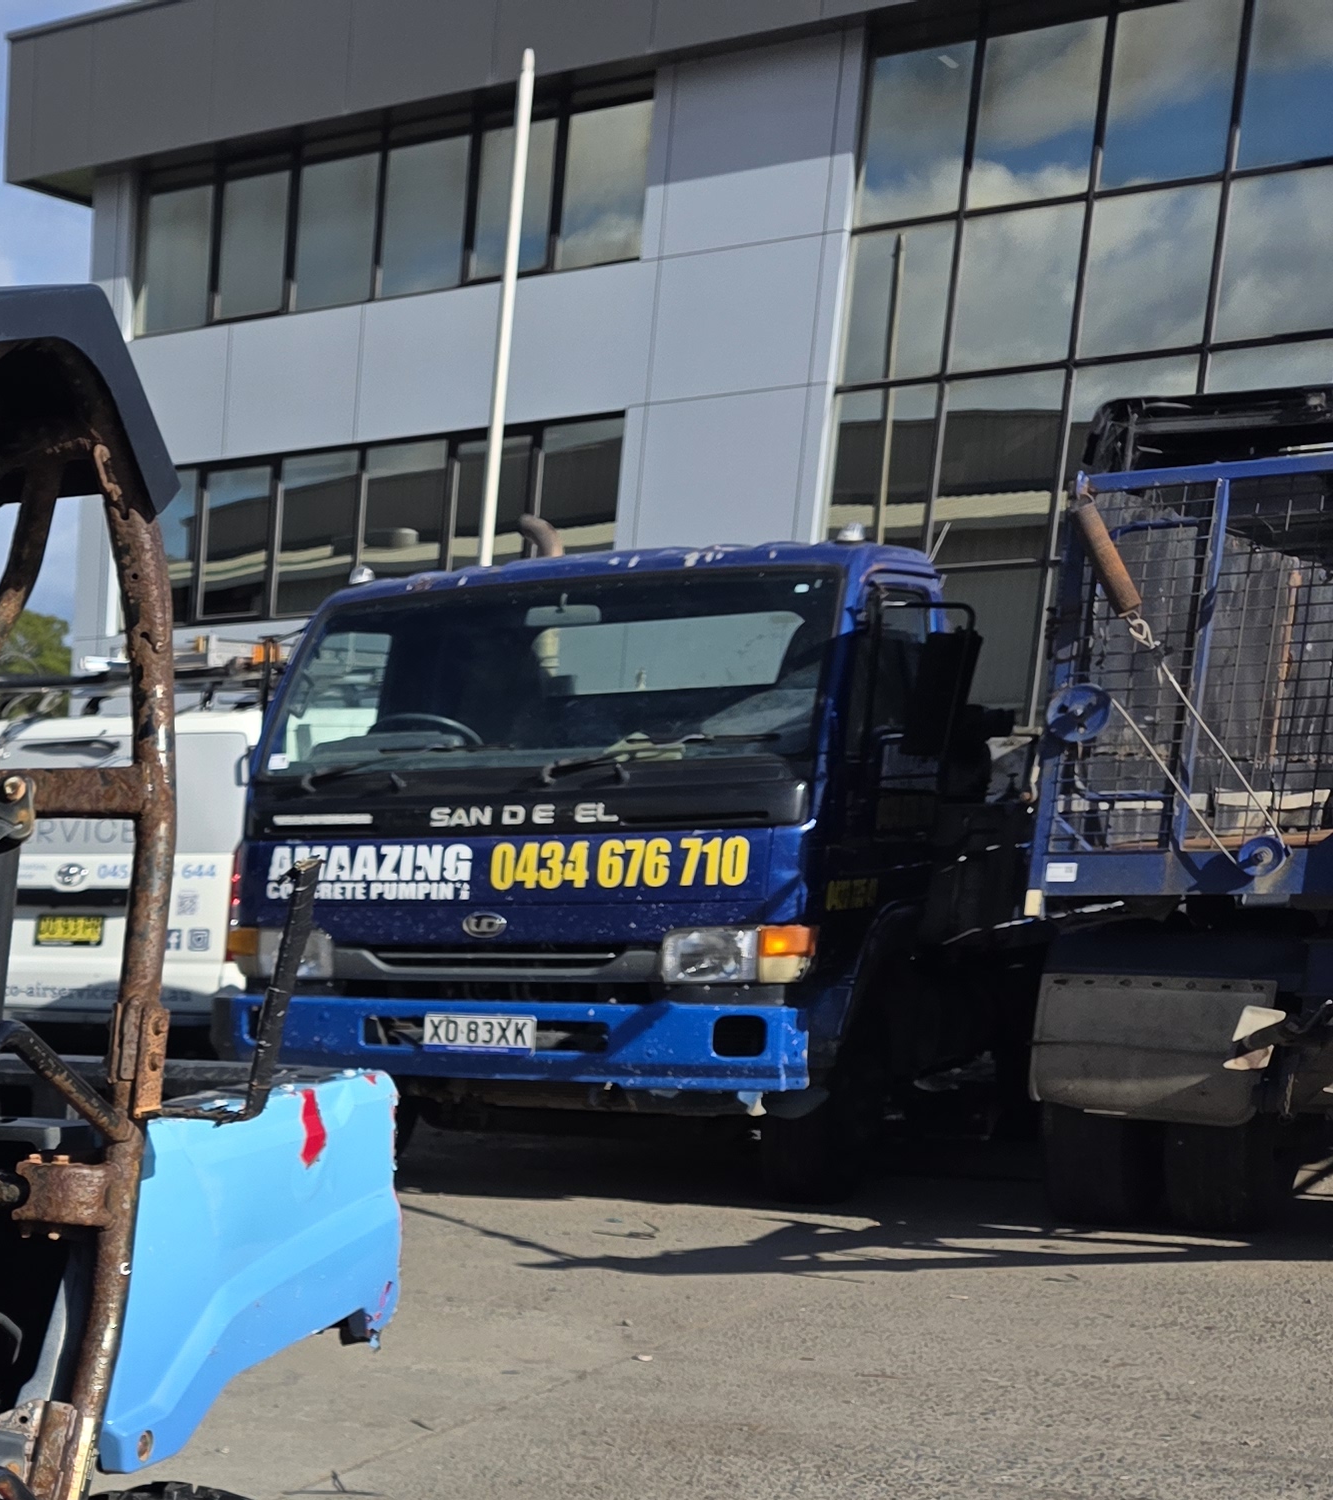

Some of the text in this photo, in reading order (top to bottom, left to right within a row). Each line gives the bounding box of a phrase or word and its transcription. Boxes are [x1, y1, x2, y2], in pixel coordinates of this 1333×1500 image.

[27, 819, 133, 843] RVICE
[490, 840, 590, 891] 0434
[596, 837, 672, 889] 676
[679, 835, 751, 887] 710
[266, 881, 367, 901] CORETE
